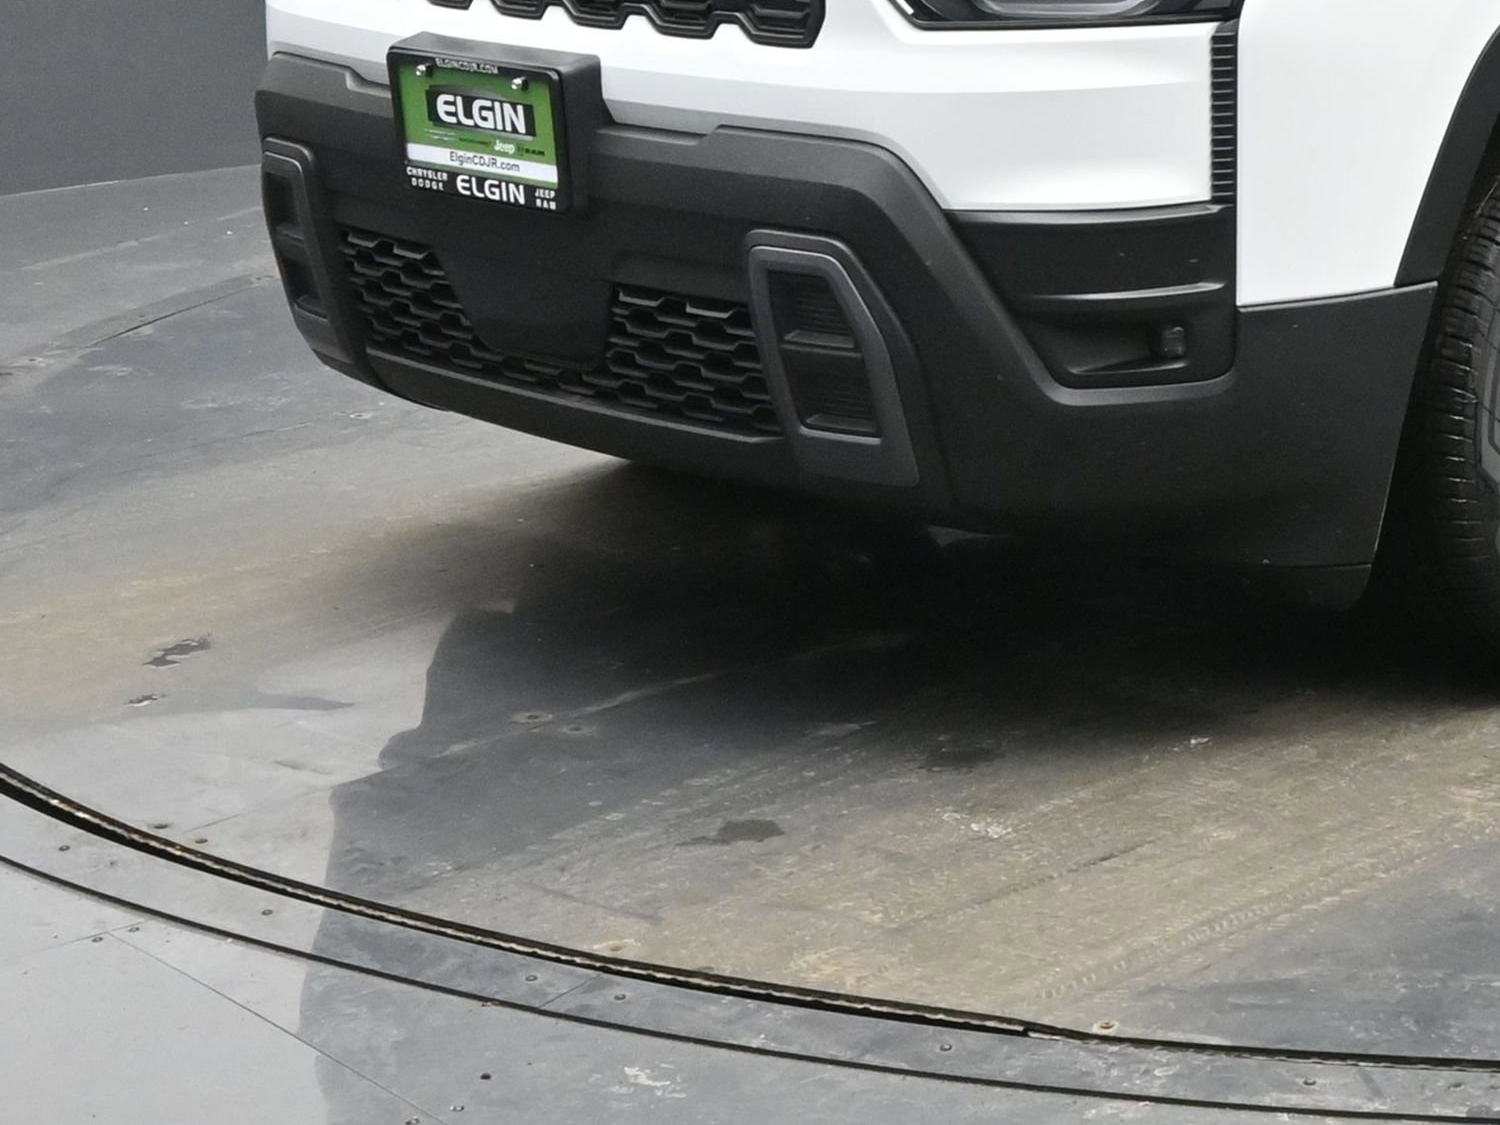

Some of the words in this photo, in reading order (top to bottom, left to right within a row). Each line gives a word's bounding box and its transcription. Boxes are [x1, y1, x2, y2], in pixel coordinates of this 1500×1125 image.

[436, 93, 527, 135] ELGIN
[449, 151, 521, 172] ElginCDJR.com
[406, 166, 448, 182] CHRYSLER
[411, 177, 444, 191] DODGE
[456, 174, 526, 205] ELGIN
[534, 188, 556, 199] JEEP
[535, 199, 557, 210] RAM
